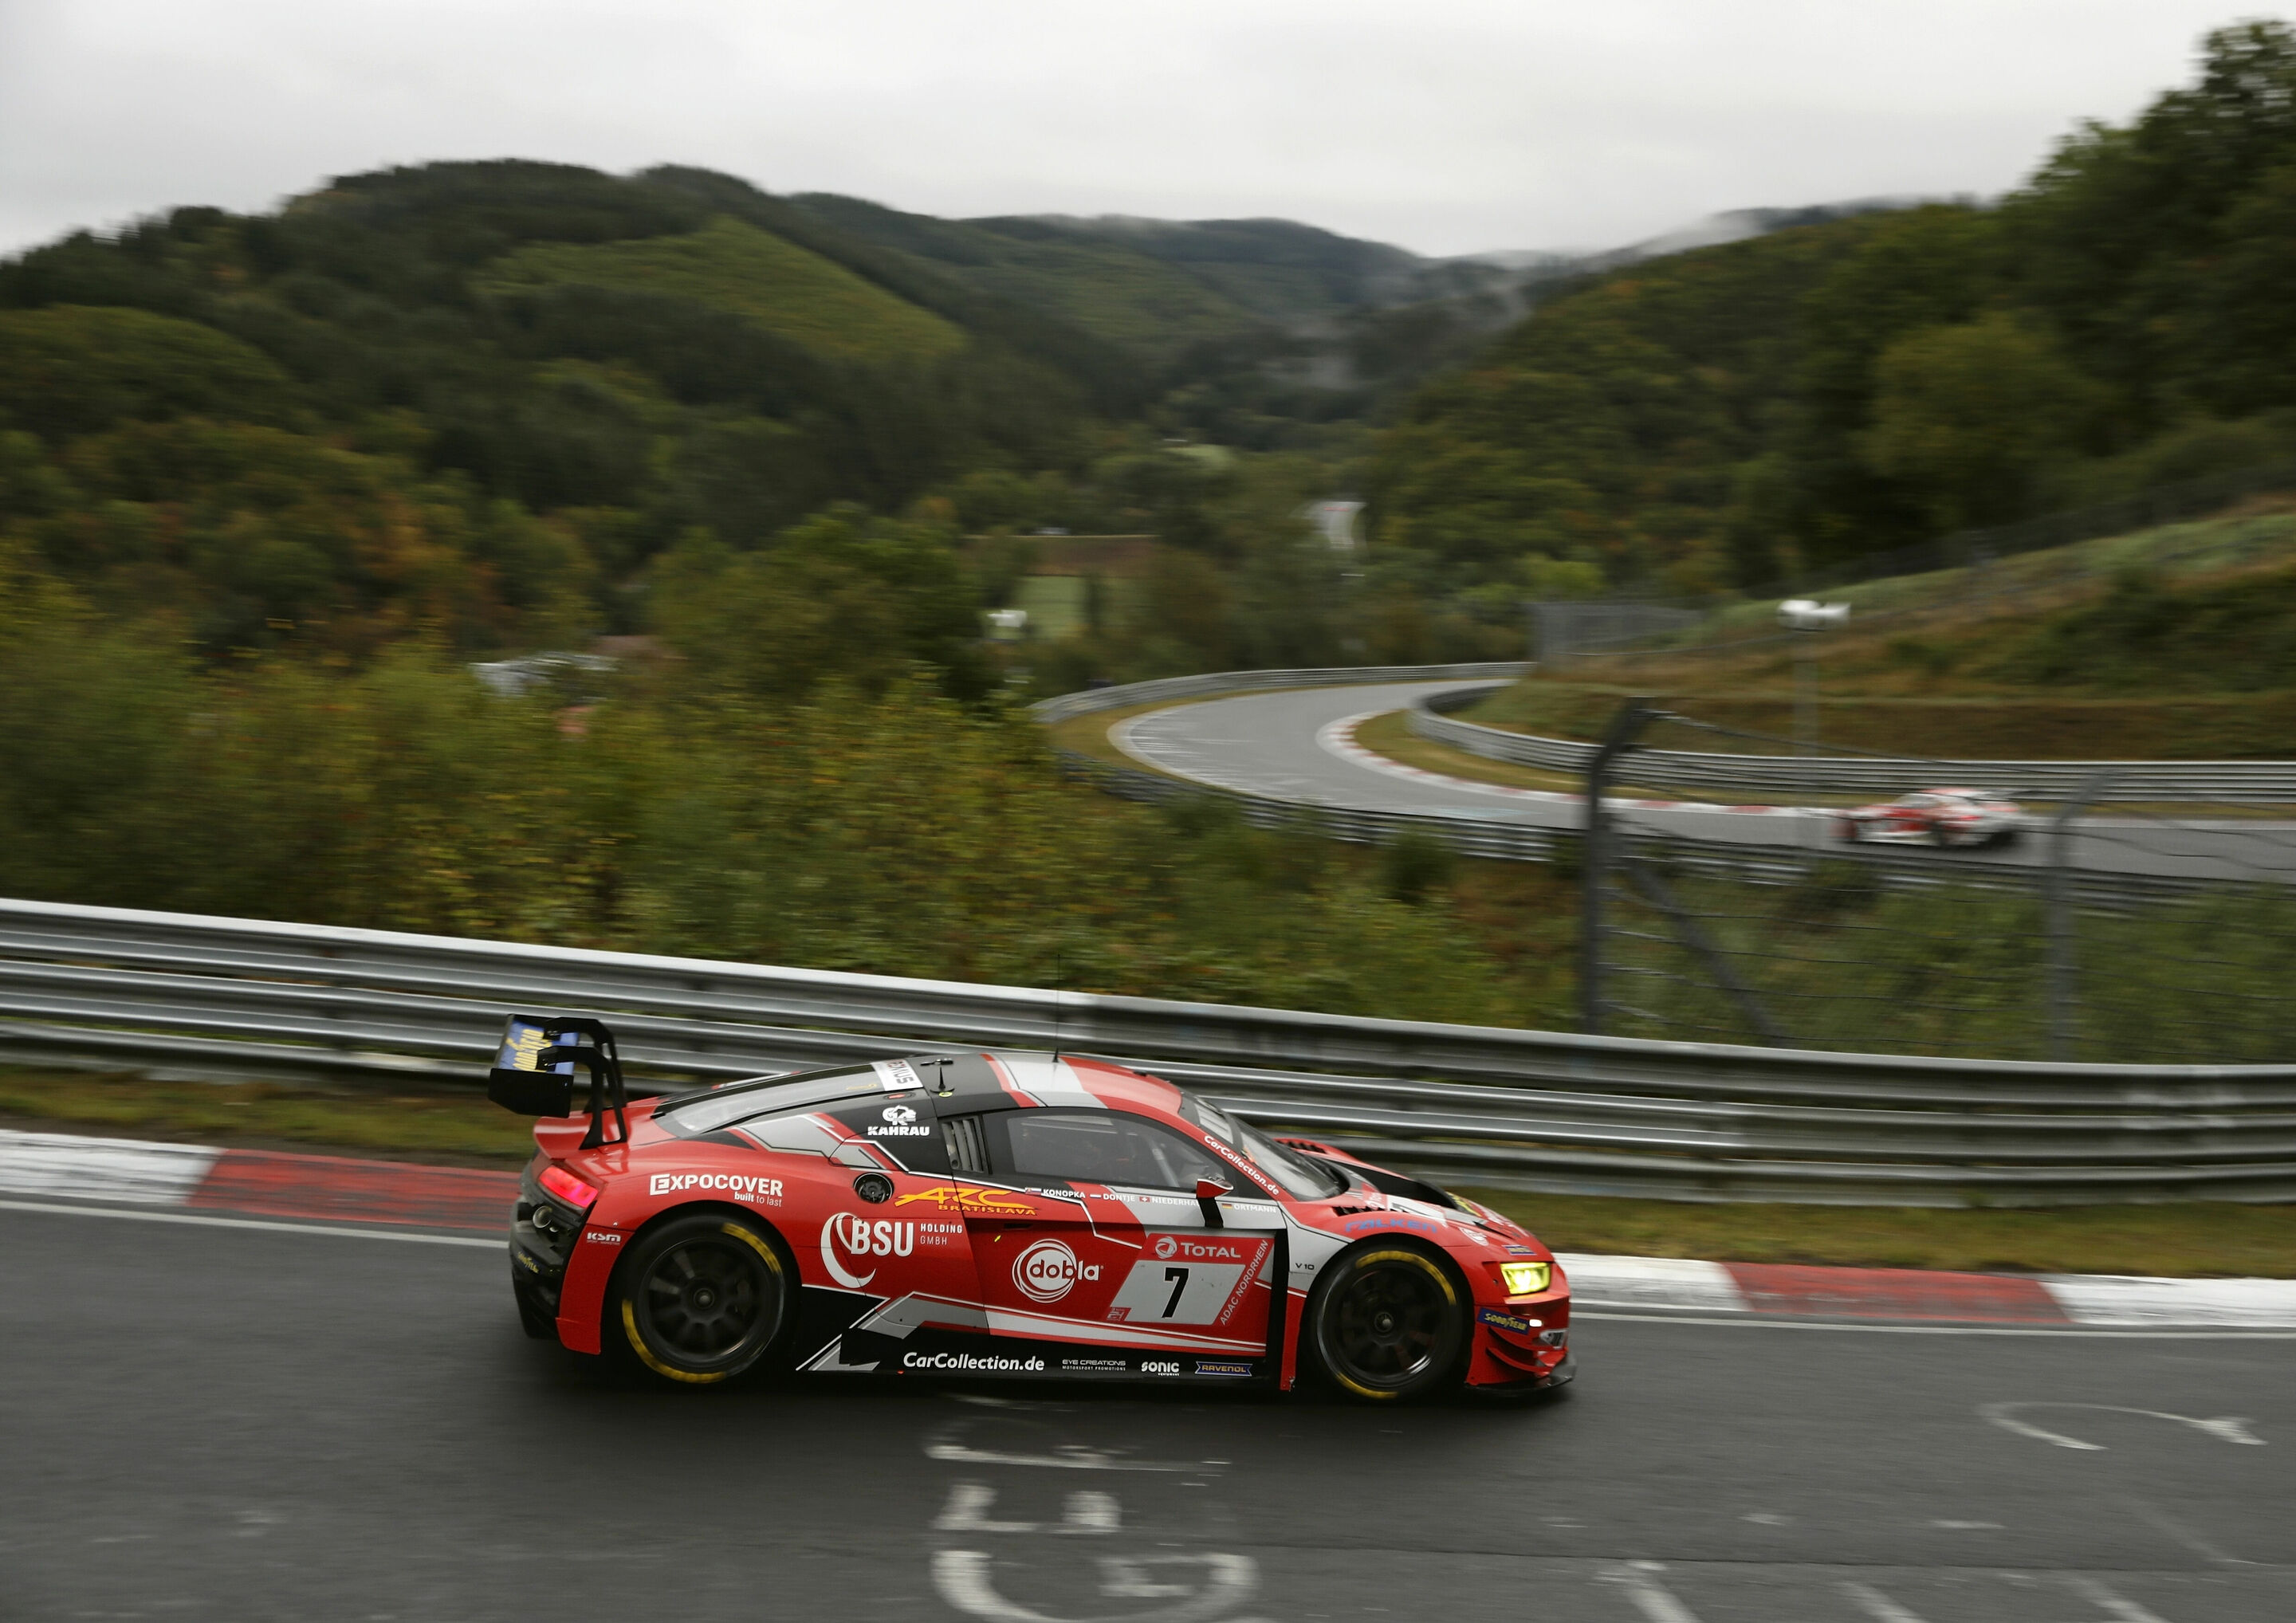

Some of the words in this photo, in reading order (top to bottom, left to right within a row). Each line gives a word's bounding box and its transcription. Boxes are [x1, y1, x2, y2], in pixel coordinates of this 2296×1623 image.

[867, 1126, 930, 1136] KAHRAU
[1204, 1135, 1280, 1195] CarCollection.de
[650, 1173, 783, 1197] EXPOCOVER
[734, 1191, 754, 1202] built
[767, 1197, 782, 1207] last
[1043, 1189, 1086, 1198] KONOPKA
[1103, 1193, 1135, 1202] DONTJE
[938, 1204, 1037, 1216] BRATISLAVA
[1234, 1203, 1276, 1212] ORTMANN
[920, 1223, 963, 1234] HOLDING
[1345, 1219, 1438, 1233] FALKEN
[587, 1232, 621, 1243] KSM
[851, 1220, 914, 1257] BSU
[920, 1236, 947, 1245] GMBH
[1181, 1242, 1241, 1258] TOTAL
[1029, 1259, 1100, 1281] dobla
[1220, 1297, 1240, 1326] ADAC
[1236, 1240, 1269, 1297] NORDRHEIN
[1161, 1267, 1190, 1318] 7
[903, 1352, 1045, 1371] CarCollection.de
